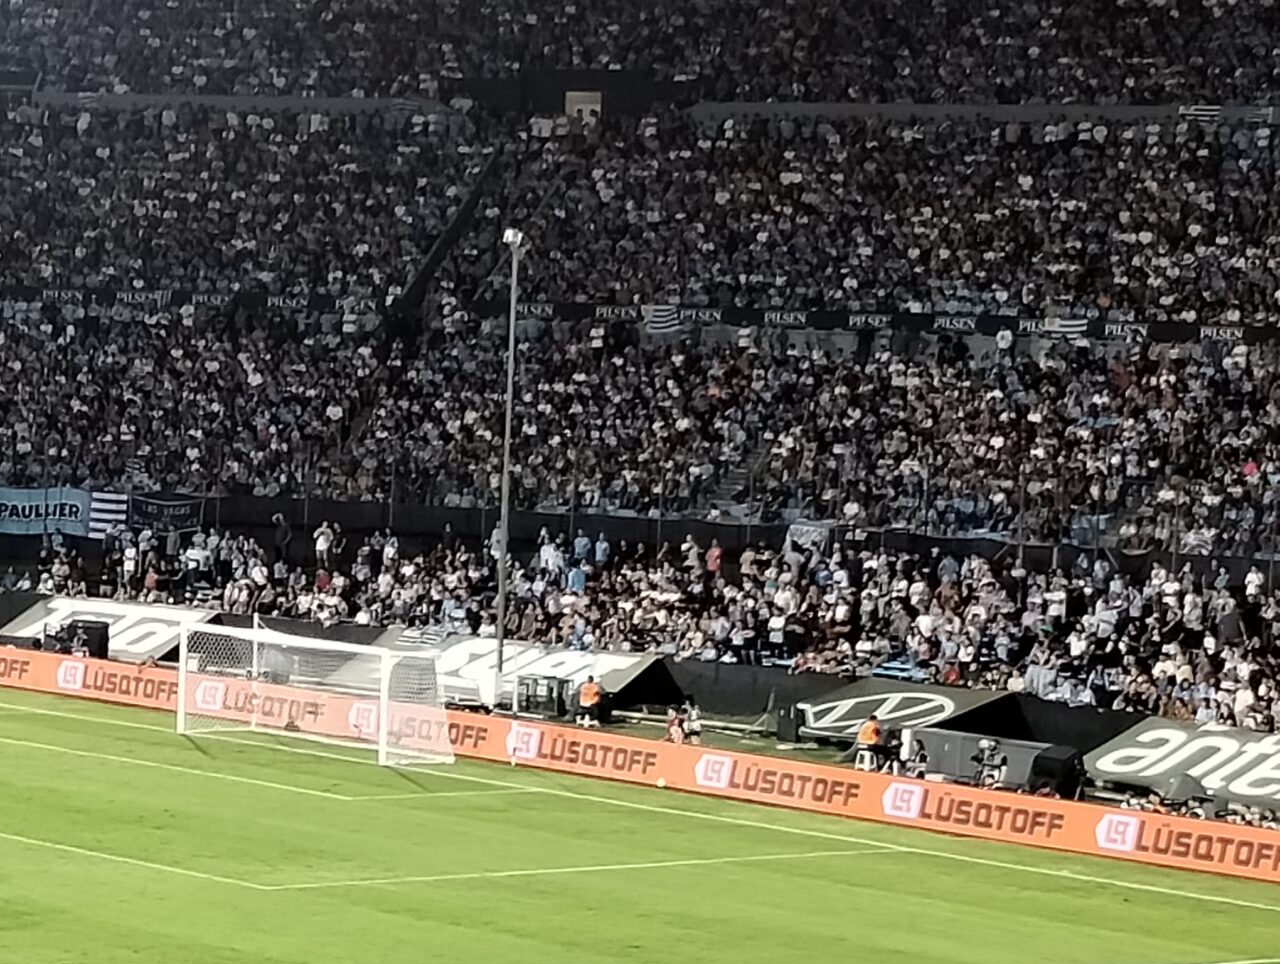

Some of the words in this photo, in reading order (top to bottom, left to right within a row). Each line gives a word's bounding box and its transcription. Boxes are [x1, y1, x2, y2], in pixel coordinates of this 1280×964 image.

[764, 312, 806, 323] PILSEN
[933, 318, 976, 329] PILSEN
[1200, 326, 1243, 338] PILSEN
